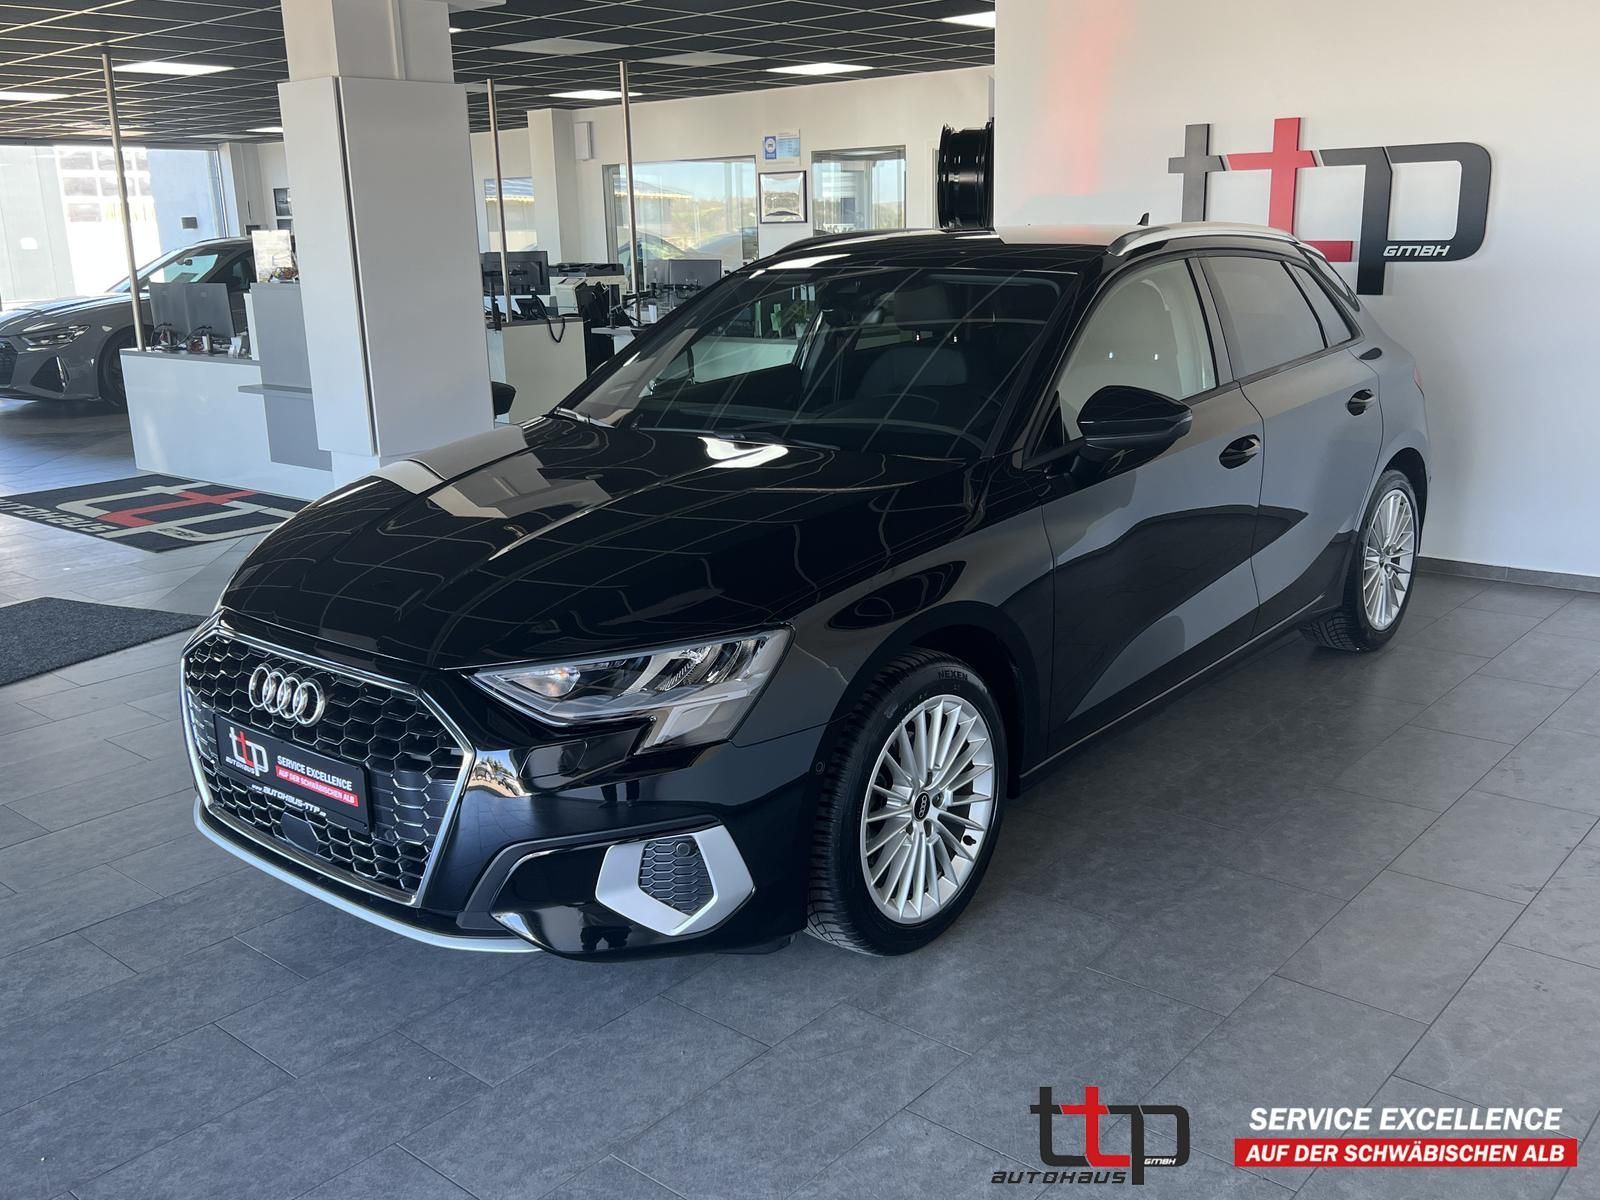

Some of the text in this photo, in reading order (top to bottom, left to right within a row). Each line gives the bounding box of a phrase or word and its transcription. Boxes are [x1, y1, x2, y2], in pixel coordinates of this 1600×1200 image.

[937, 669, 968, 681] NEXEN
[277, 755, 352, 791] SERVICE EXCELLENCE
[343, 793, 355, 804] ALB
